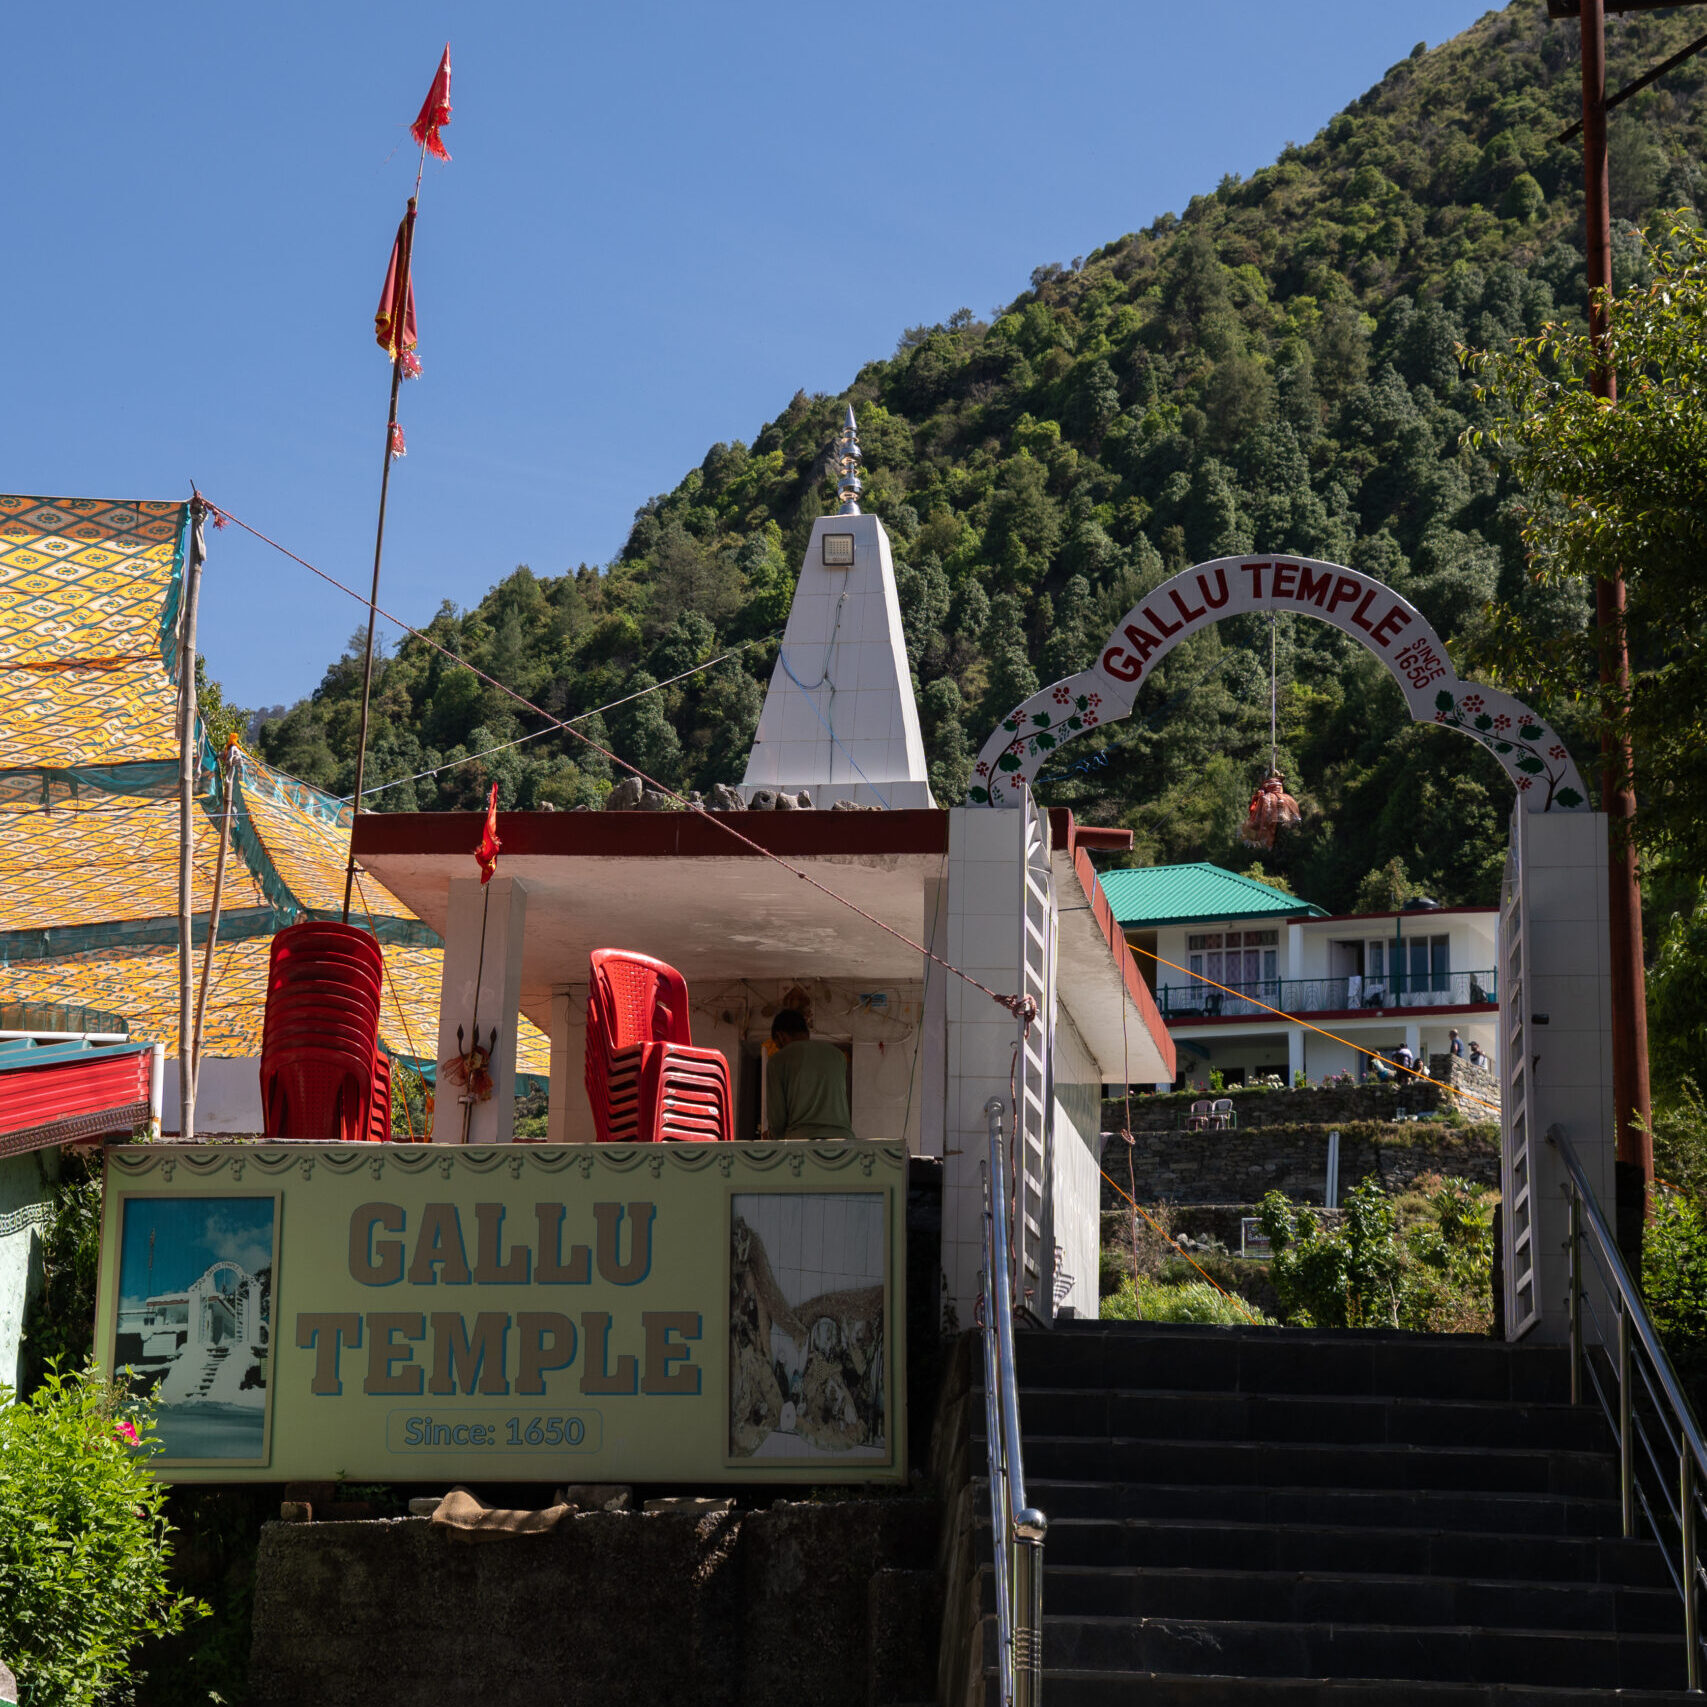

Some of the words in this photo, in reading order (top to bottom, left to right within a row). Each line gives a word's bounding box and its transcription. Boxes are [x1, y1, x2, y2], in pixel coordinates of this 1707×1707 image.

[1102, 568, 1230, 683] GALLU
[1241, 562, 1412, 648] TEMPLE
[1394, 646, 1430, 689] 1650
[1412, 637, 1446, 680] SINCE
[348, 1202, 657, 1287] GALLU
[296, 1311, 703, 1396] TEMPLE
[405, 1416, 496, 1446] Since:
[505, 1416, 586, 1446] 1650
